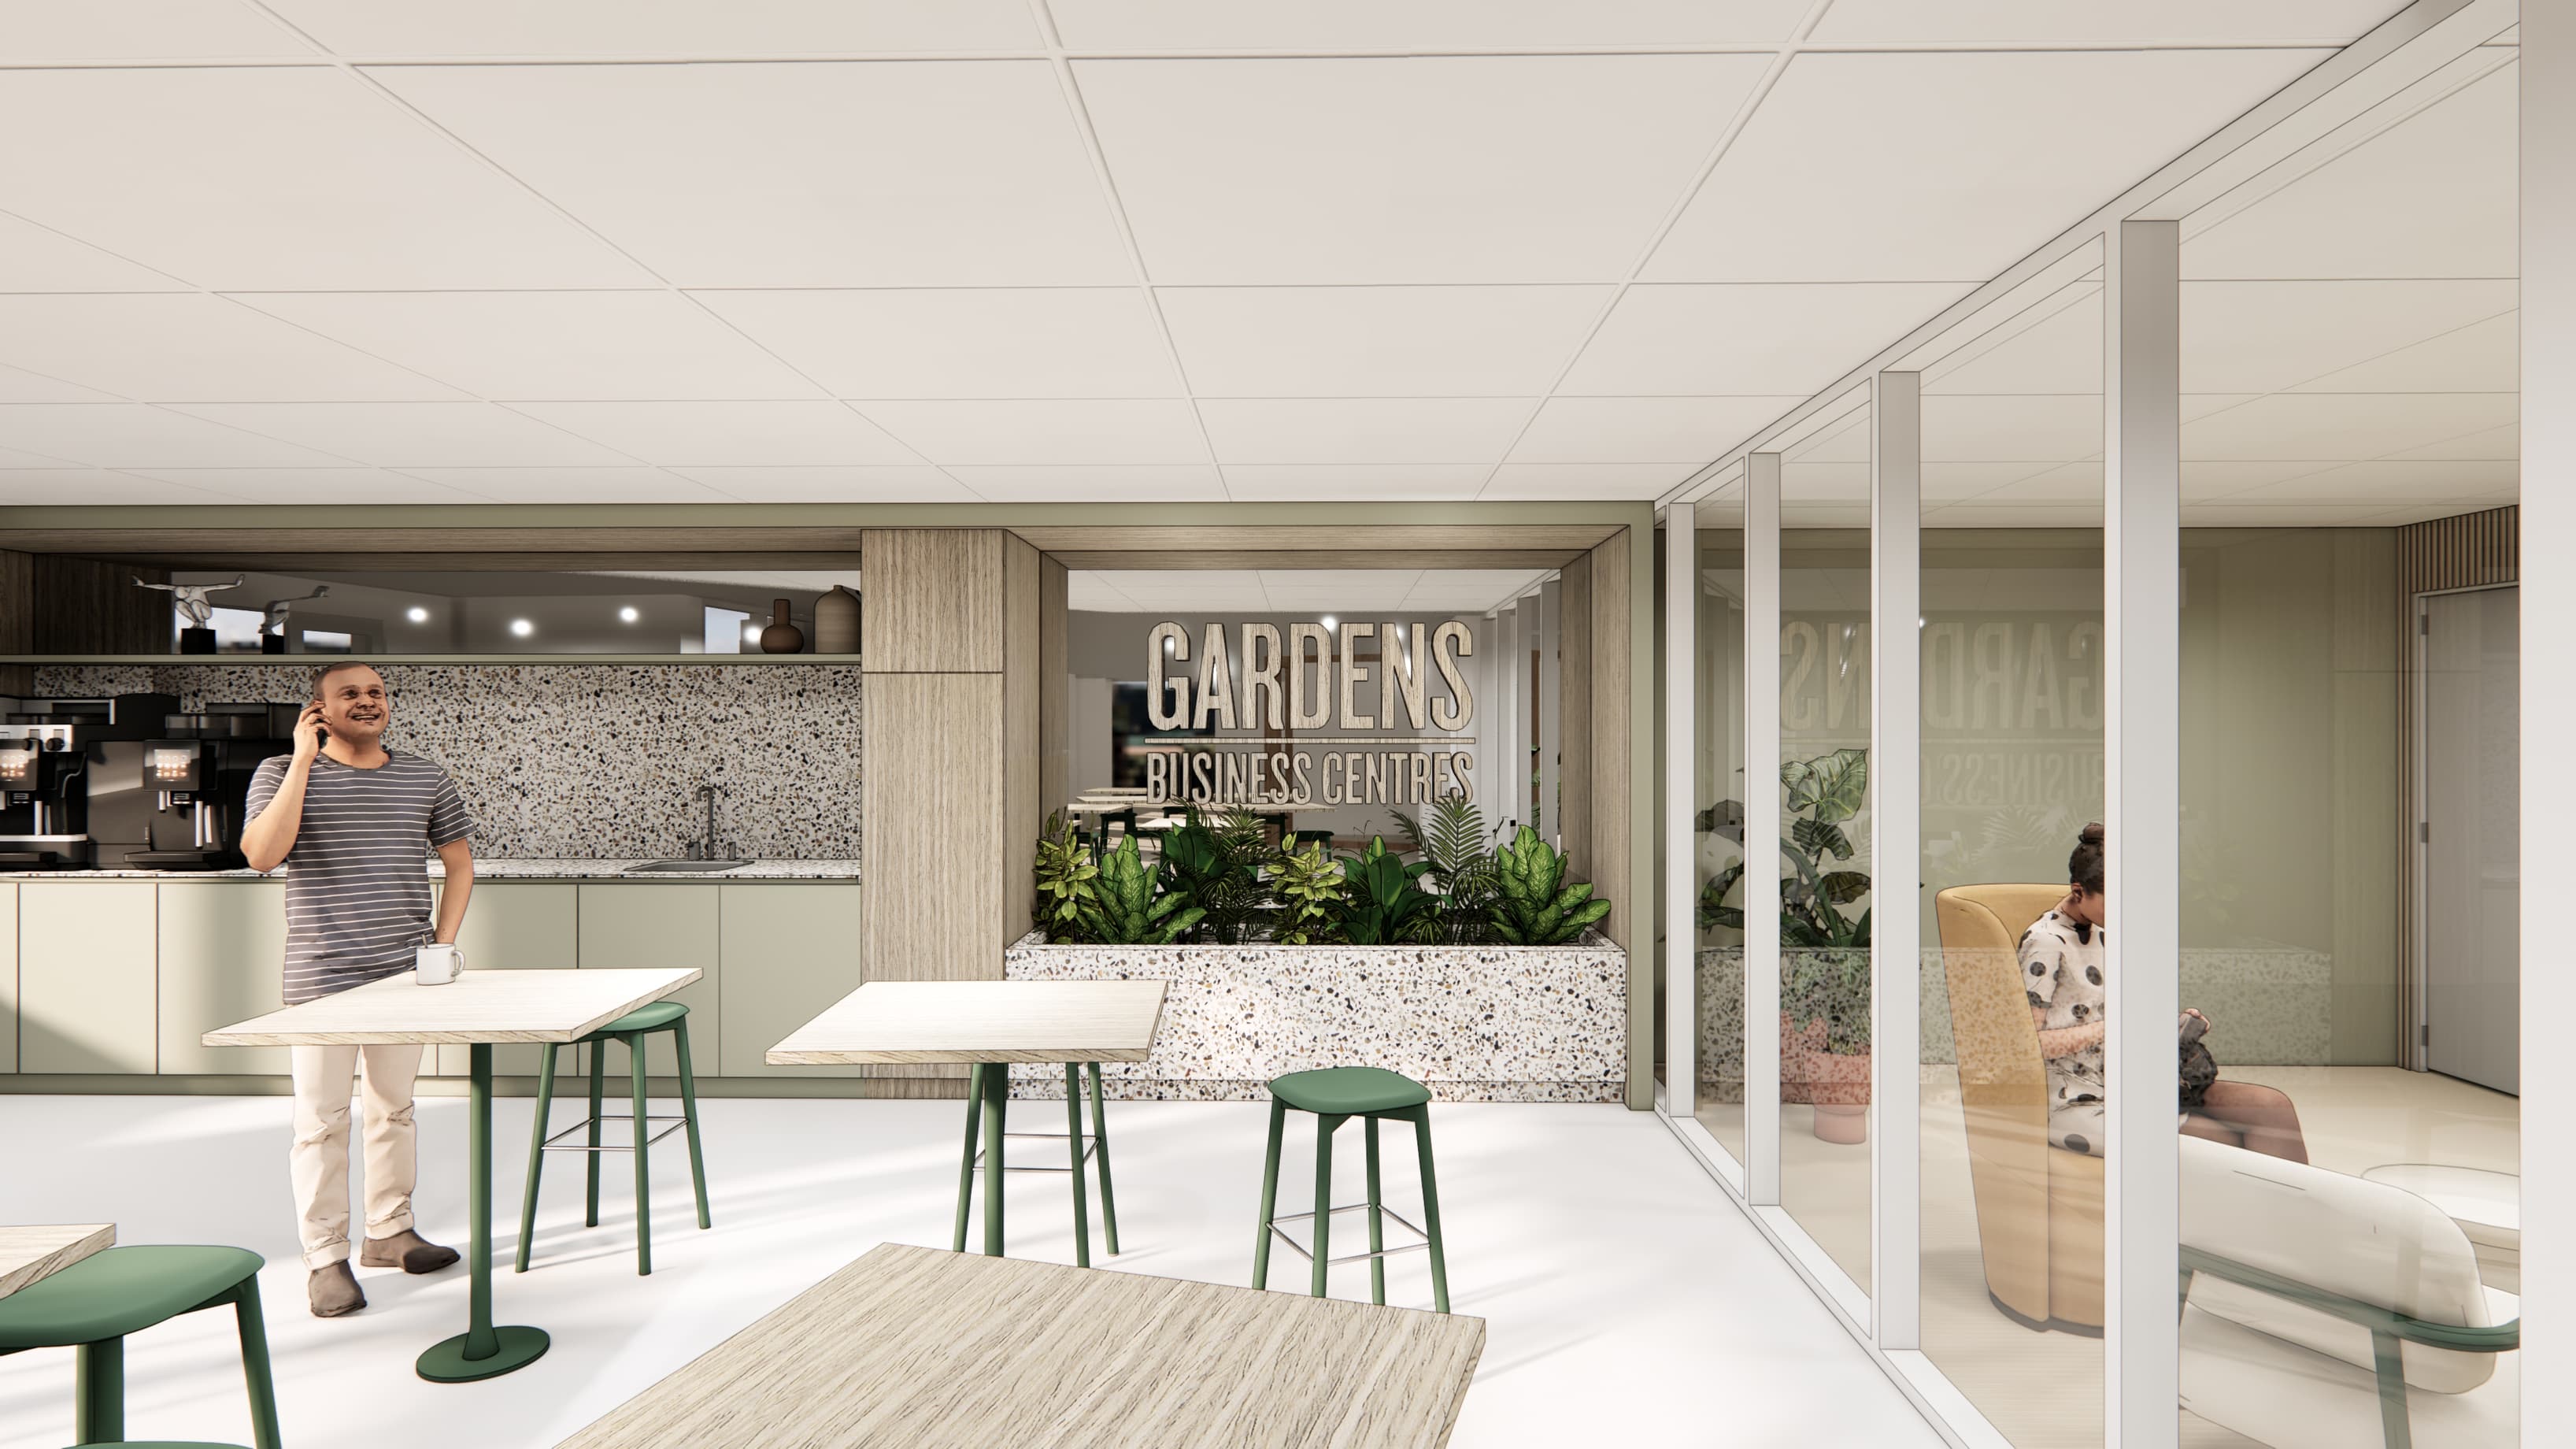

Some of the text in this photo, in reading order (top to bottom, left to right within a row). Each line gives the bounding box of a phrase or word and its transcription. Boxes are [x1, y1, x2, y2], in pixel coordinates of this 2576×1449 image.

[1147, 621, 1473, 731] GARDENS
[1146, 751, 1473, 805] BUSINESS CENTRES
